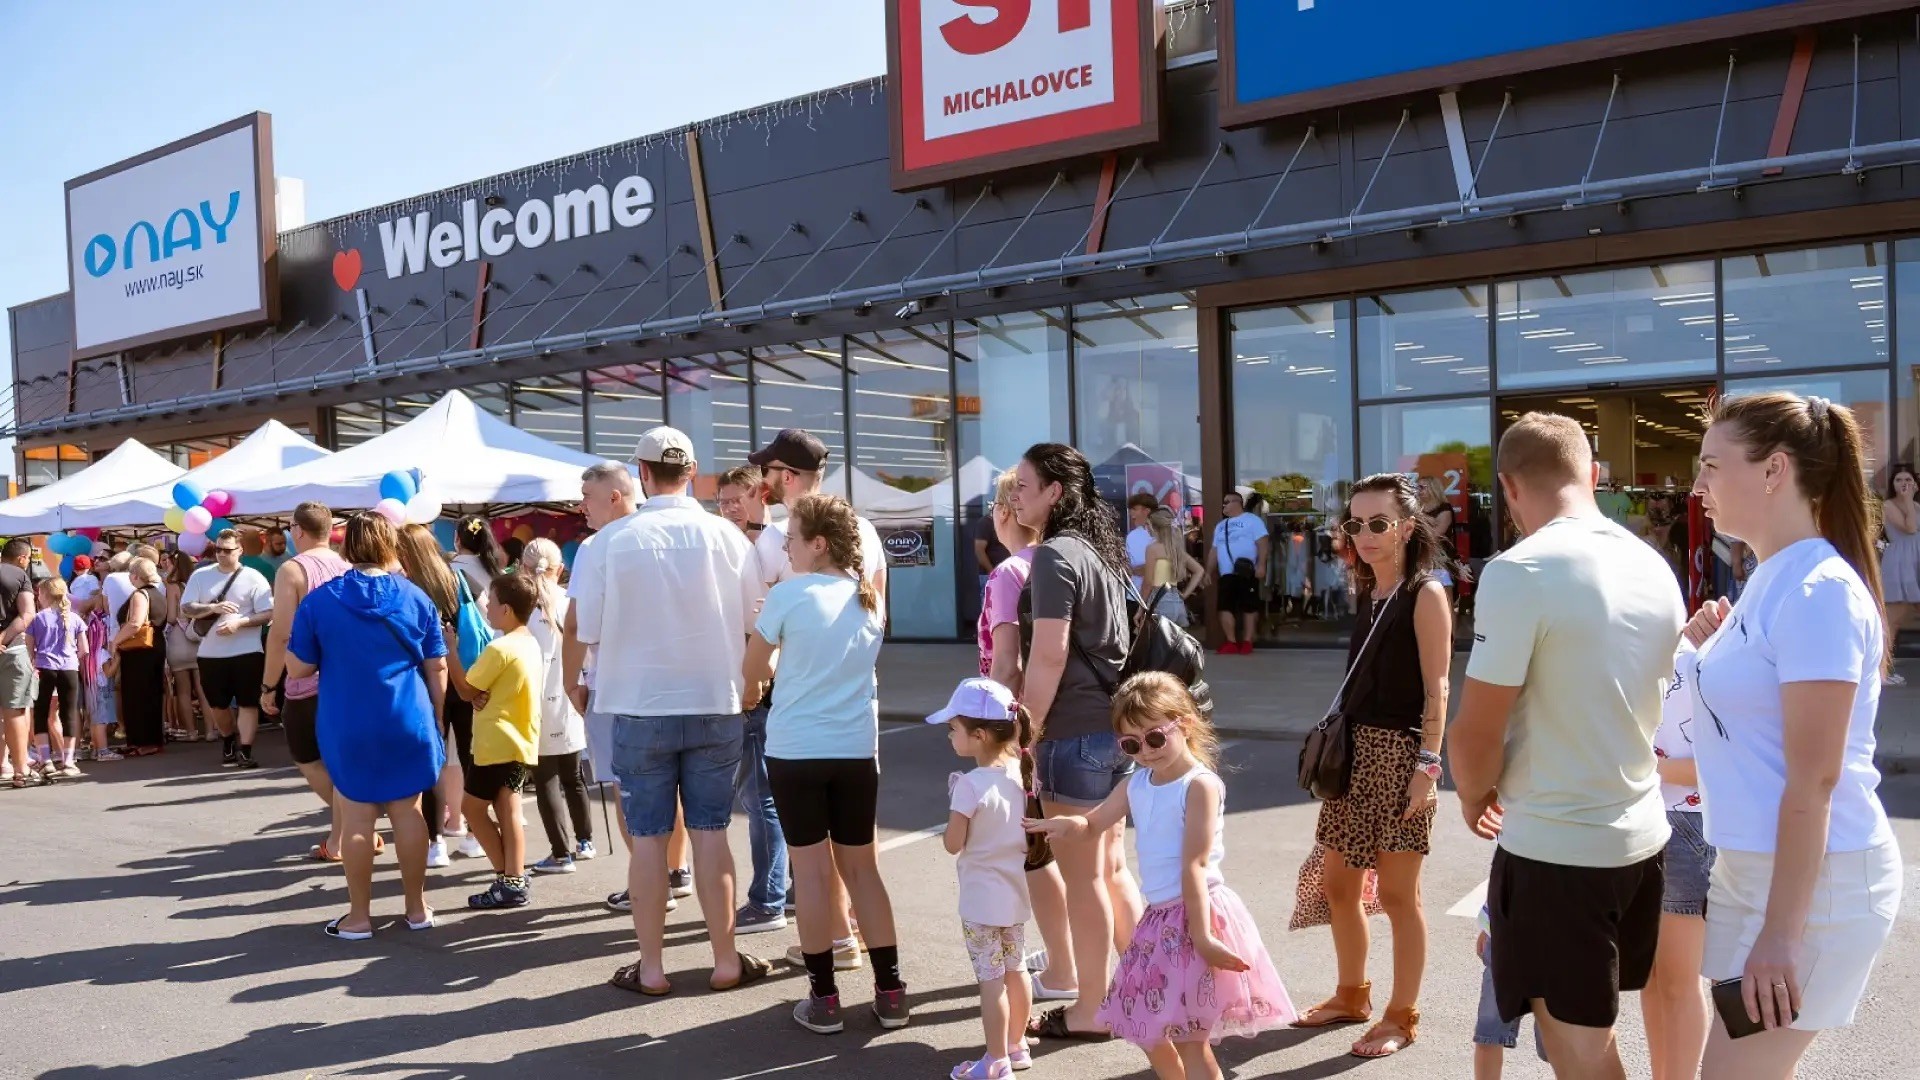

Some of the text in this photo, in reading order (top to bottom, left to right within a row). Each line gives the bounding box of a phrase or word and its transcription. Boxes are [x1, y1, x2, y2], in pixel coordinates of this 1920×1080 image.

[943, 64, 1093, 116] MICHALOVCE
[378, 175, 655, 279] Welcome
[124, 264, 204, 298] www.nay.sk
